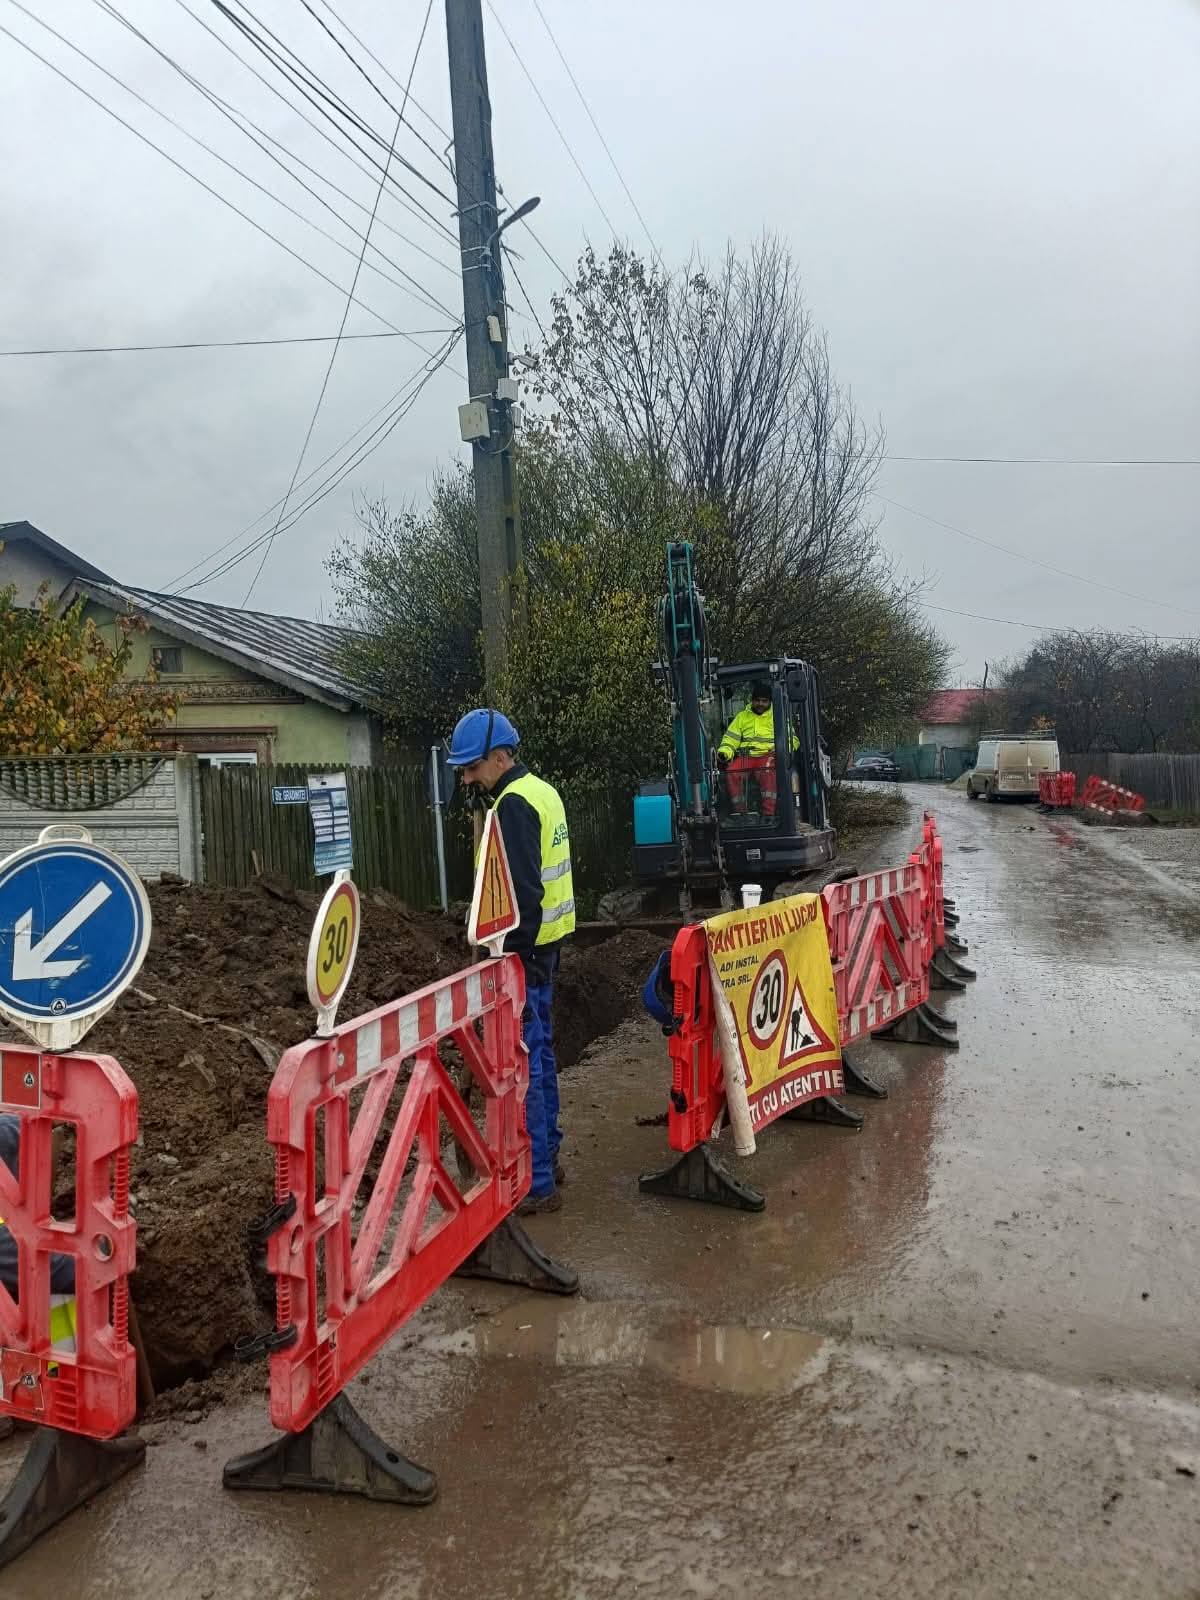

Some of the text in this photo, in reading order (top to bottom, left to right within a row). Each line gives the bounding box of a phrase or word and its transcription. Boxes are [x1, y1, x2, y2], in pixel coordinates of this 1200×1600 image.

[769, 914, 786, 939] IN
[784, 901, 818, 934] LUCRU
[323, 916, 348, 973] 30
[720, 954, 759, 973] ADI INSTAL
[756, 969, 781, 1030] 30
[762, 1089, 779, 1116] CU
[780, 1069, 845, 1107] ATENTIE
